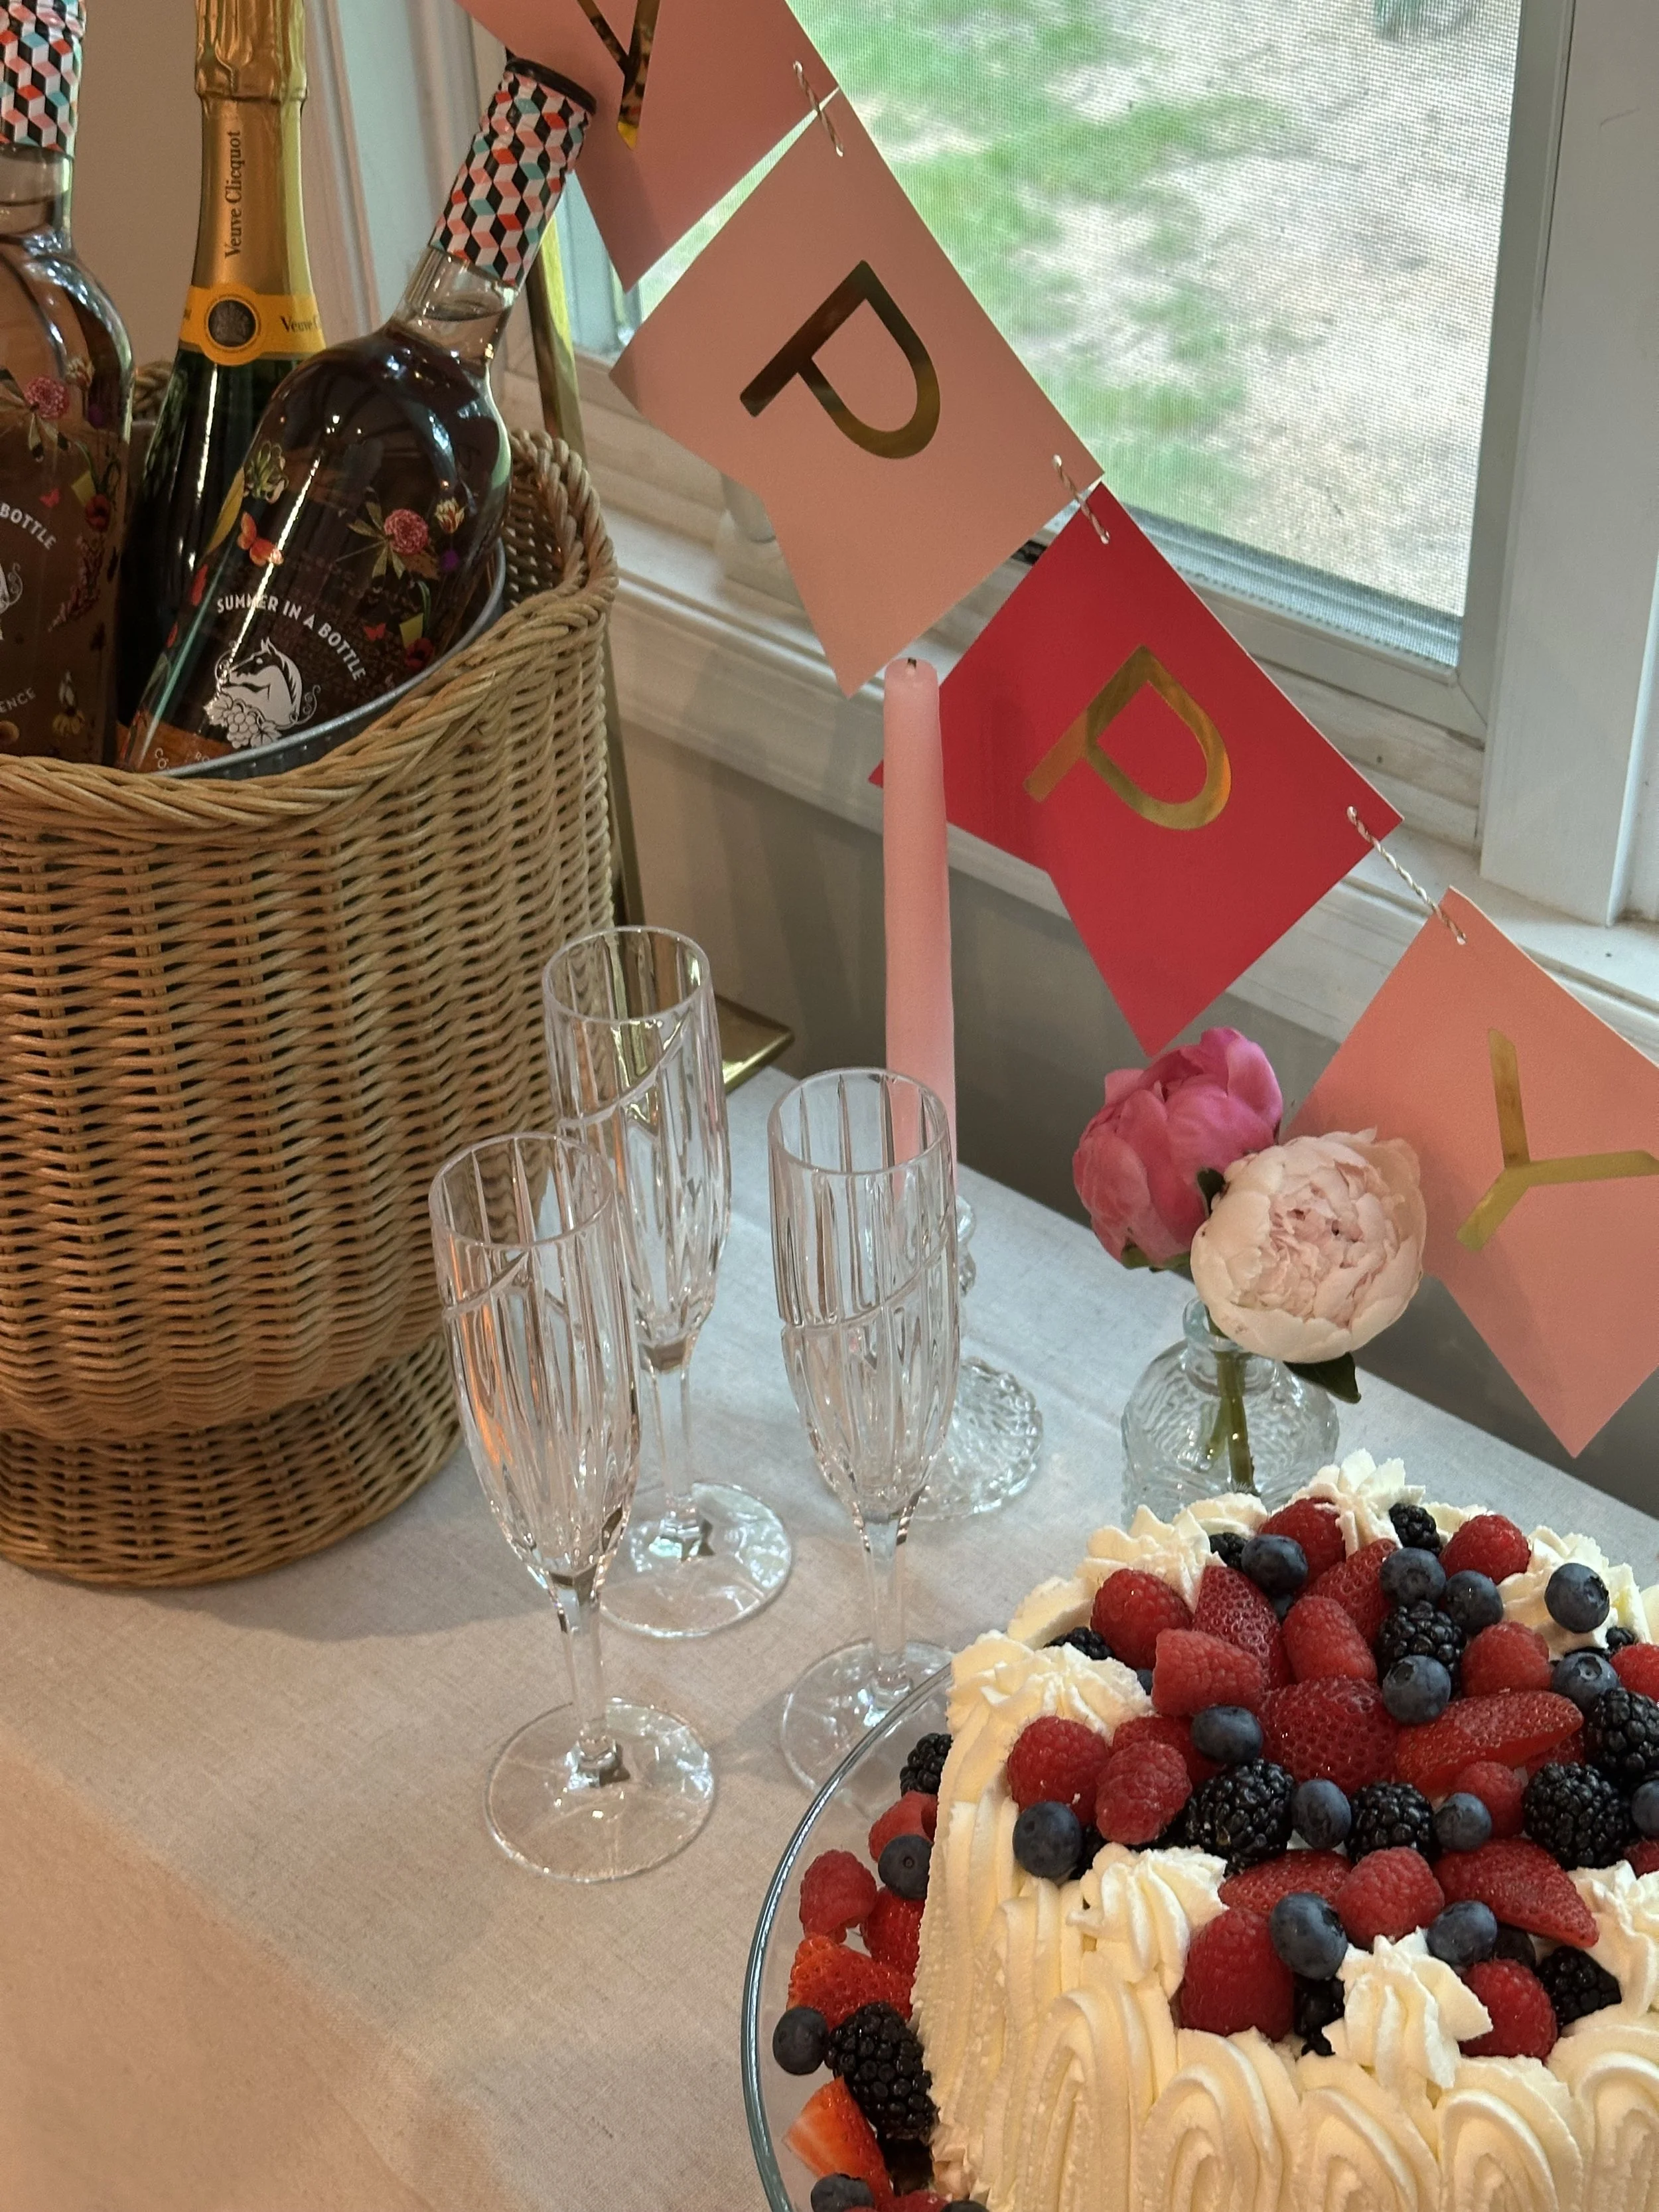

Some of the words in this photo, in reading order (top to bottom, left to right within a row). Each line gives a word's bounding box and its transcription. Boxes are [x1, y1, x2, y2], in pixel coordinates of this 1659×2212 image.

[225, 129, 246, 204] Clicquot
[225, 208, 242, 259] Veuve
[0, 502, 57, 550] BOTTLE
[217, 593, 279, 614] SUMMER
[283, 599, 301, 621] IN
[303, 613, 316, 630] A
[318, 622, 366, 681] BOTTLE
